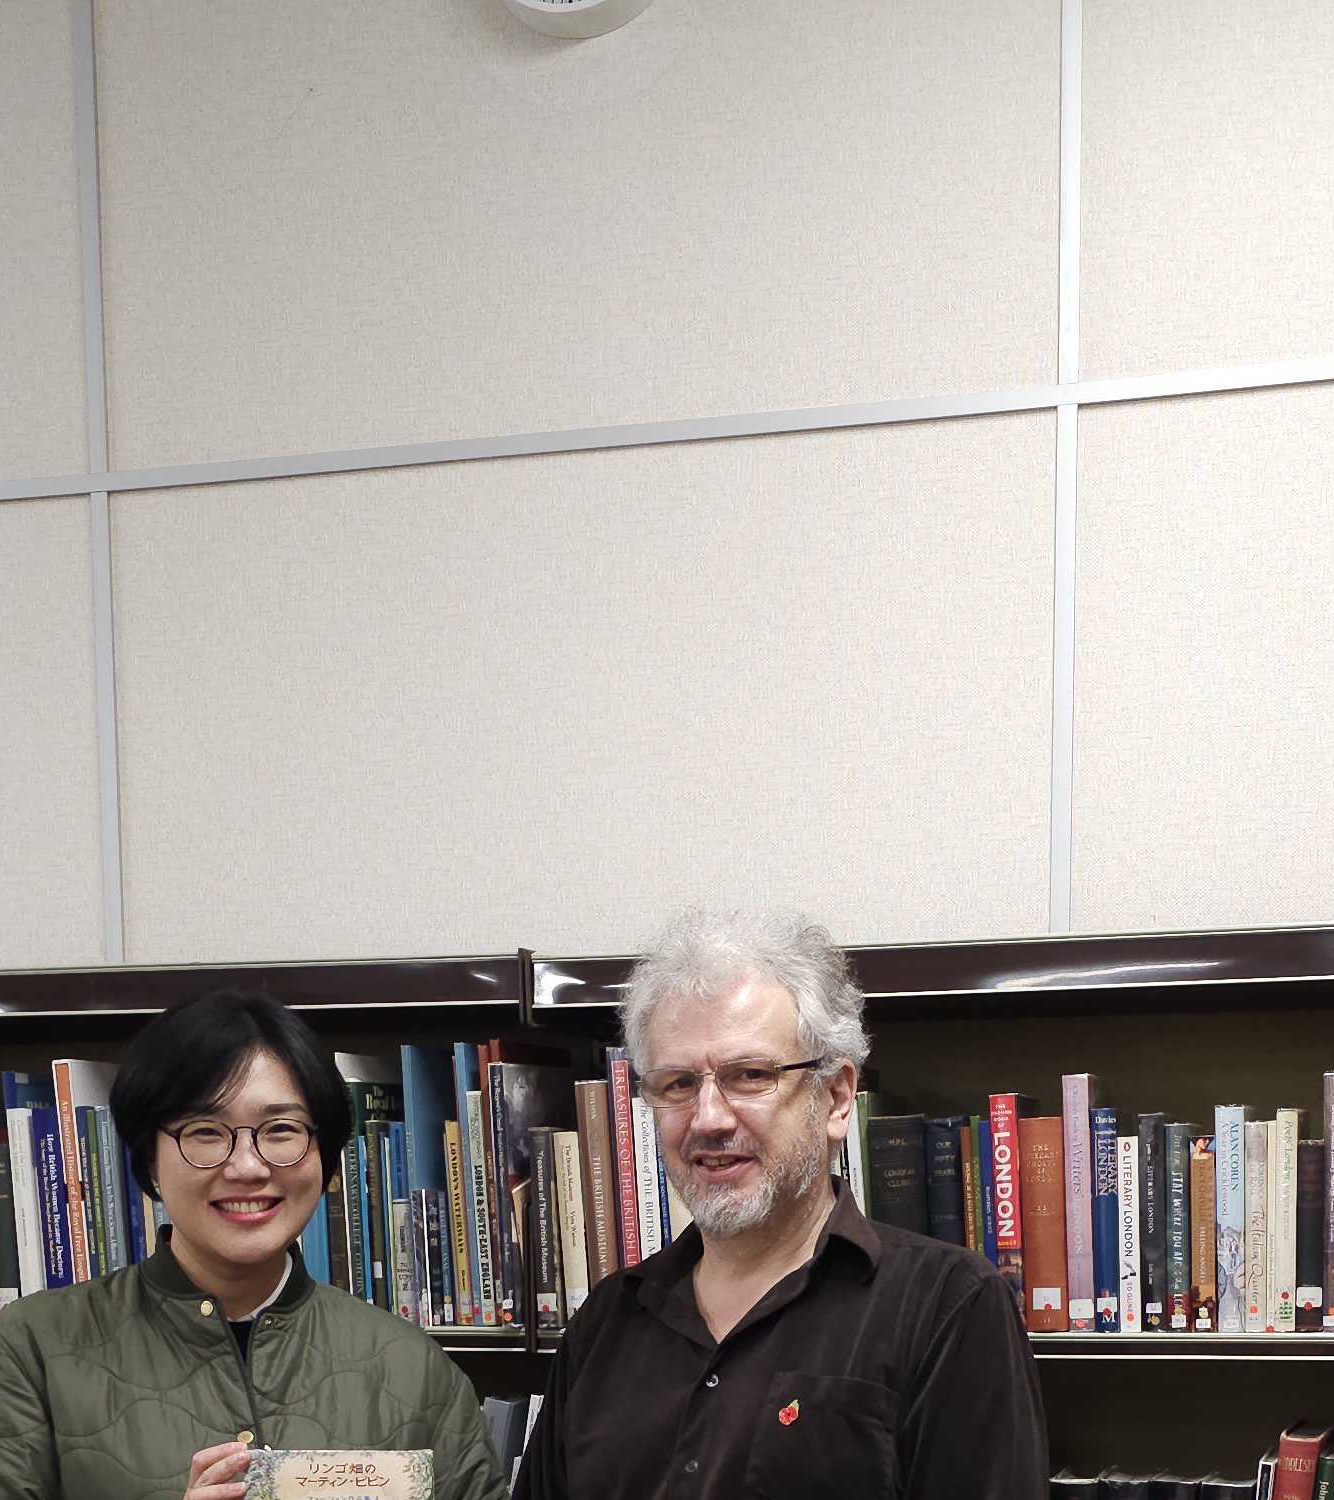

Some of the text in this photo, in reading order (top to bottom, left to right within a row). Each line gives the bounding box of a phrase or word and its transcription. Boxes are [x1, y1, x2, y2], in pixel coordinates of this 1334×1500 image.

[1095, 1116, 1116, 1124] Davies
[1230, 1121, 1240, 1191] ALAN COREN
[614, 1067, 636, 1255] TREASURES OF THE BRITISH
[994, 1132, 1014, 1237] LONDON
[1098, 1137, 1108, 1196] LONDON
[1222, 1134, 1230, 1216] Year Cricklewood
[1122, 1155, 1133, 1257] LITERARY LONDON
[309, 1464, 376, 1474] リンゴ畑の
